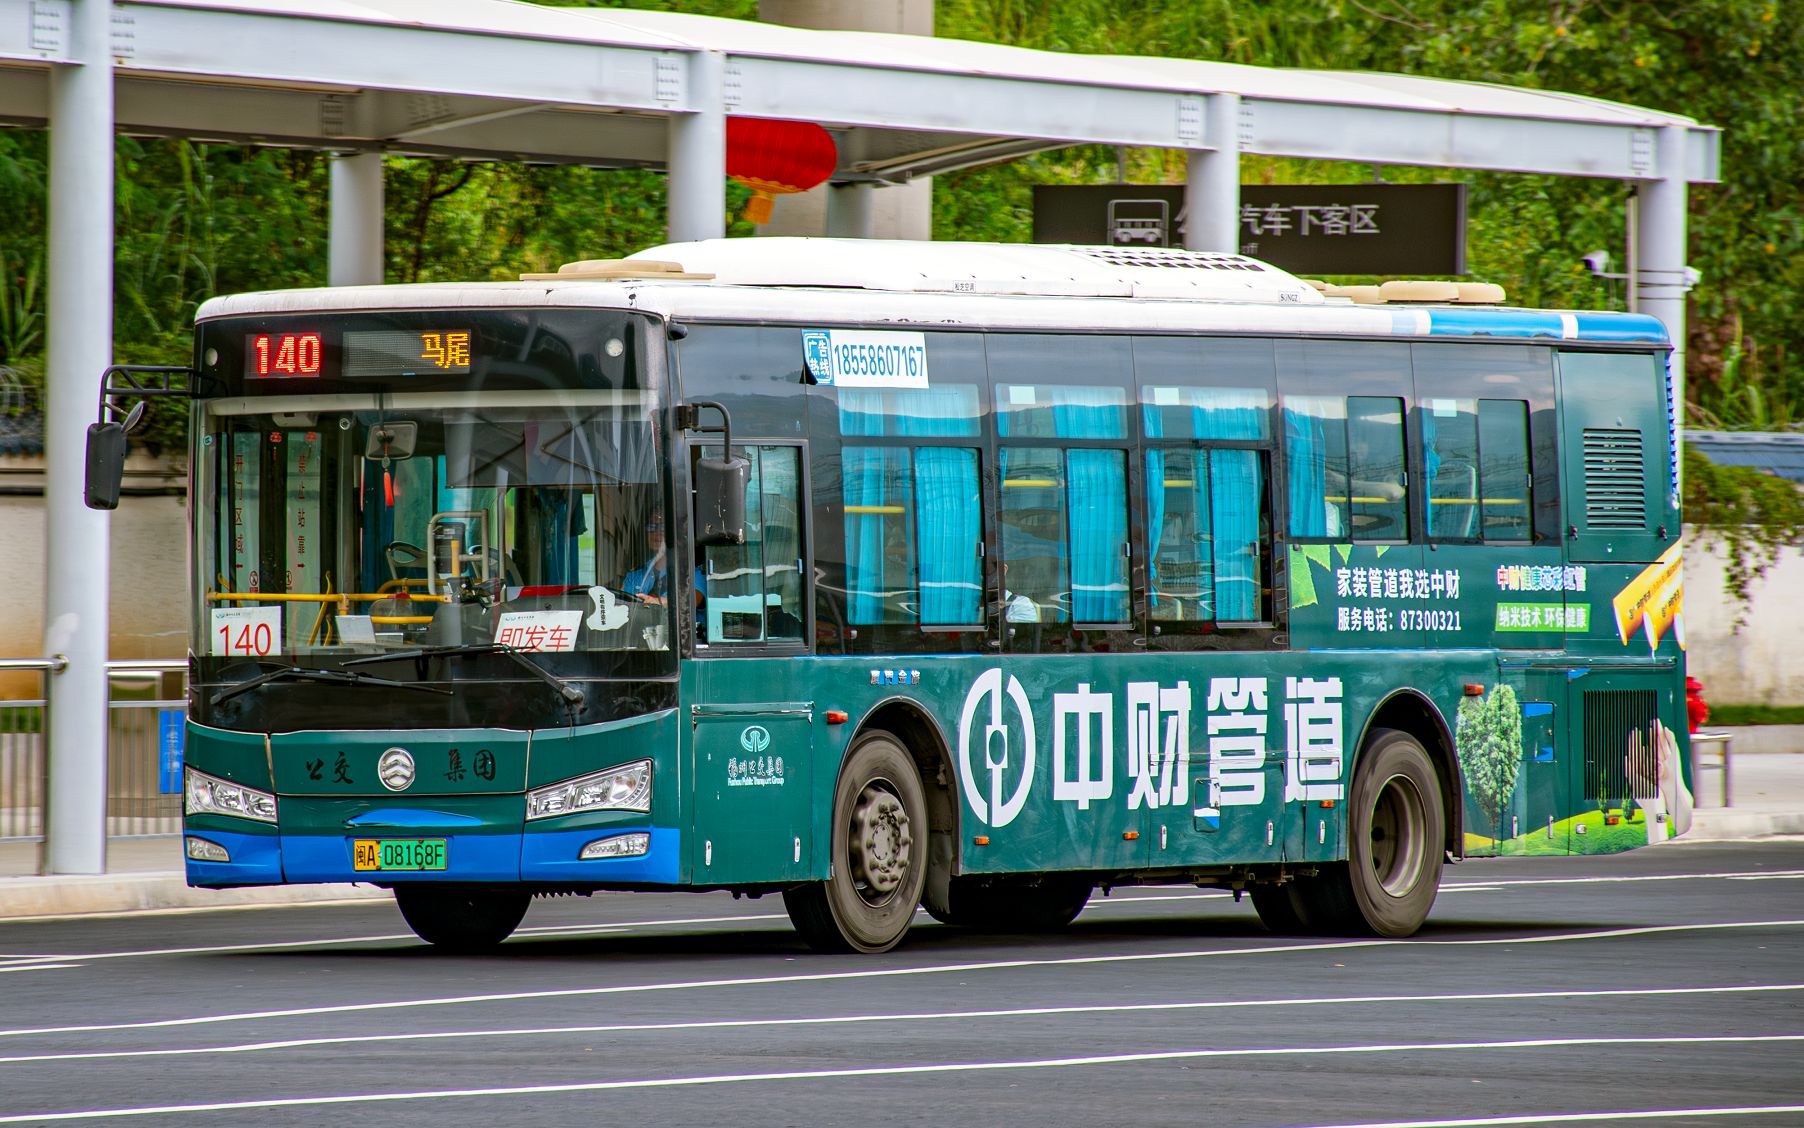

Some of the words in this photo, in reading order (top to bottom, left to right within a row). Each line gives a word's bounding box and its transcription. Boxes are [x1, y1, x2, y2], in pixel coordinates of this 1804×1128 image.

[1174, 203, 1380, 236] 汽车下客区
[256, 334, 320, 374] 140
[421, 333, 470, 369] 马尾
[808, 339, 829, 358] 广告
[834, 344, 924, 377] 18558607167
[809, 358, 831, 378] 热线
[1336, 567, 1460, 600] 家装管道我选中财
[1400, 609, 1461, 631] 87300321
[1498, 606, 1541, 628] 纳米技术
[1544, 606, 1586, 628] 环保健康
[219, 623, 271, 656] 140
[500, 625, 572, 652] 即发车
[1053, 676, 1344, 810] 中财管道
[306, 752, 354, 784] 公交
[442, 749, 496, 783] 集团
